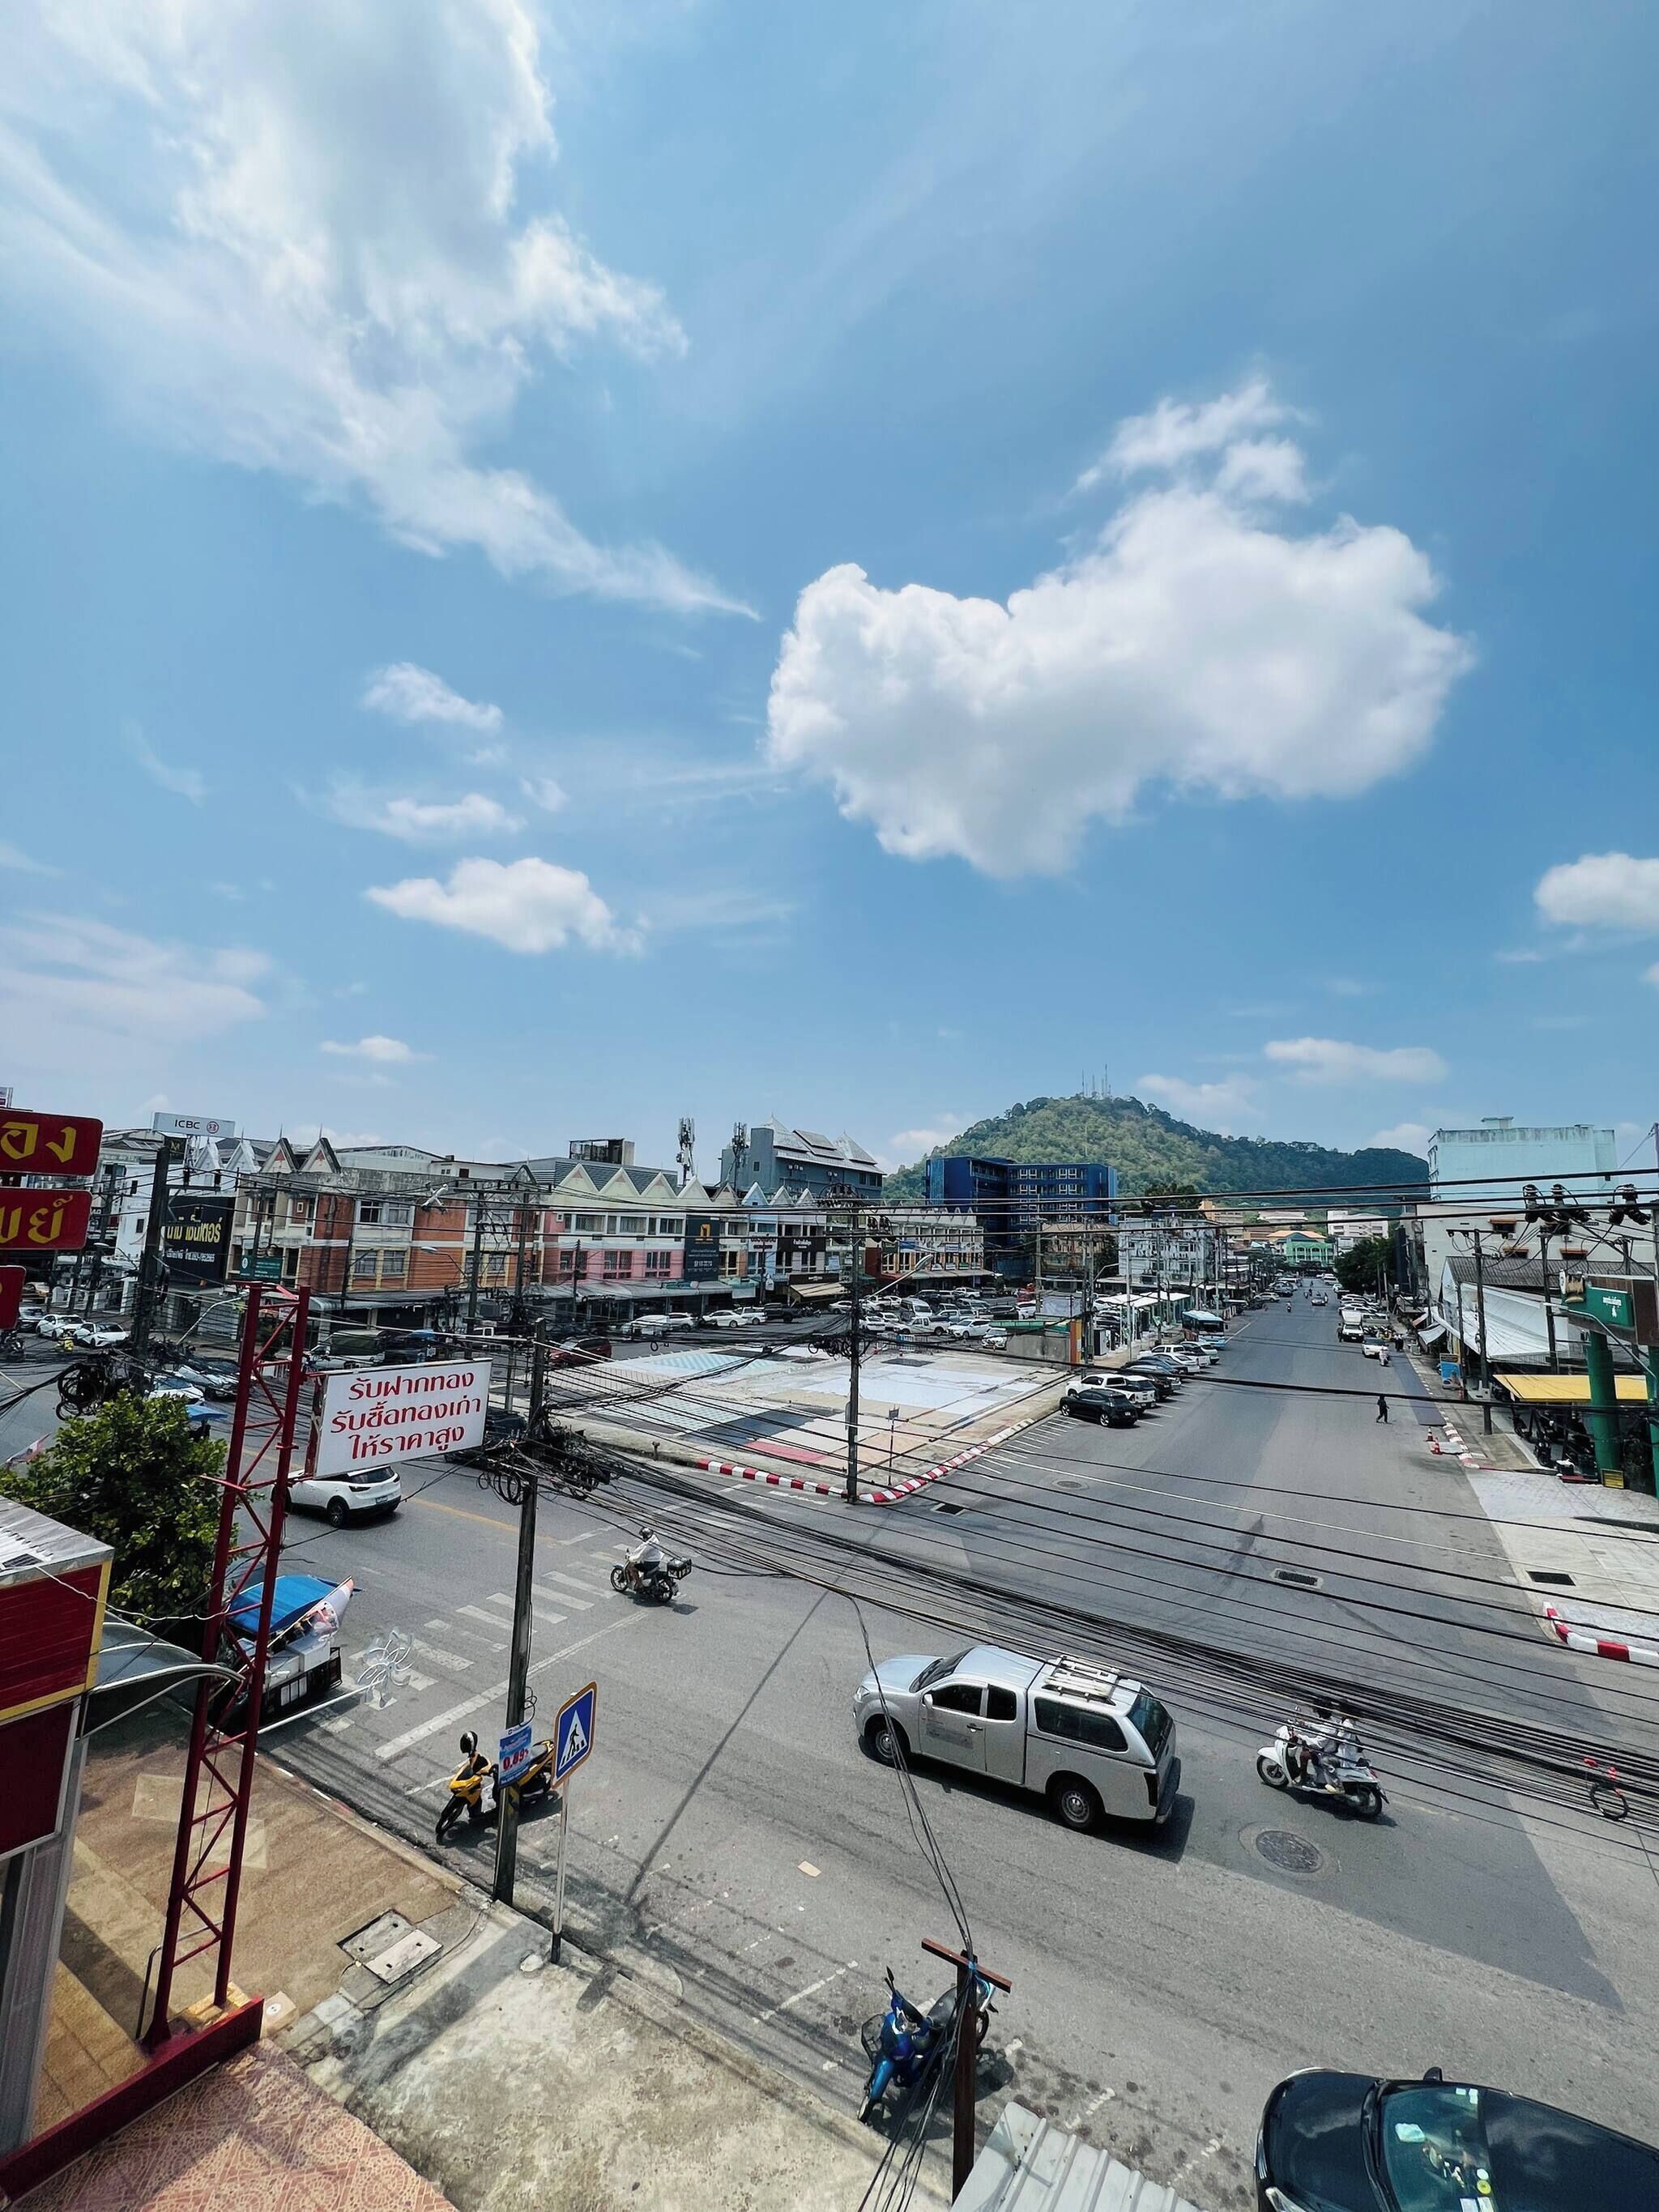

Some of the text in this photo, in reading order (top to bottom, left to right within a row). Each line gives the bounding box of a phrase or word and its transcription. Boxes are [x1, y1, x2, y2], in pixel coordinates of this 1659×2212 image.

[174, 1119, 201, 1130] ICBC
[348, 1371, 475, 1400] รับฝากทอง
[331, 1395, 481, 1434] รับซื้อทองเก่า
[348, 1426, 465, 1460] ให้ราคาสูง
